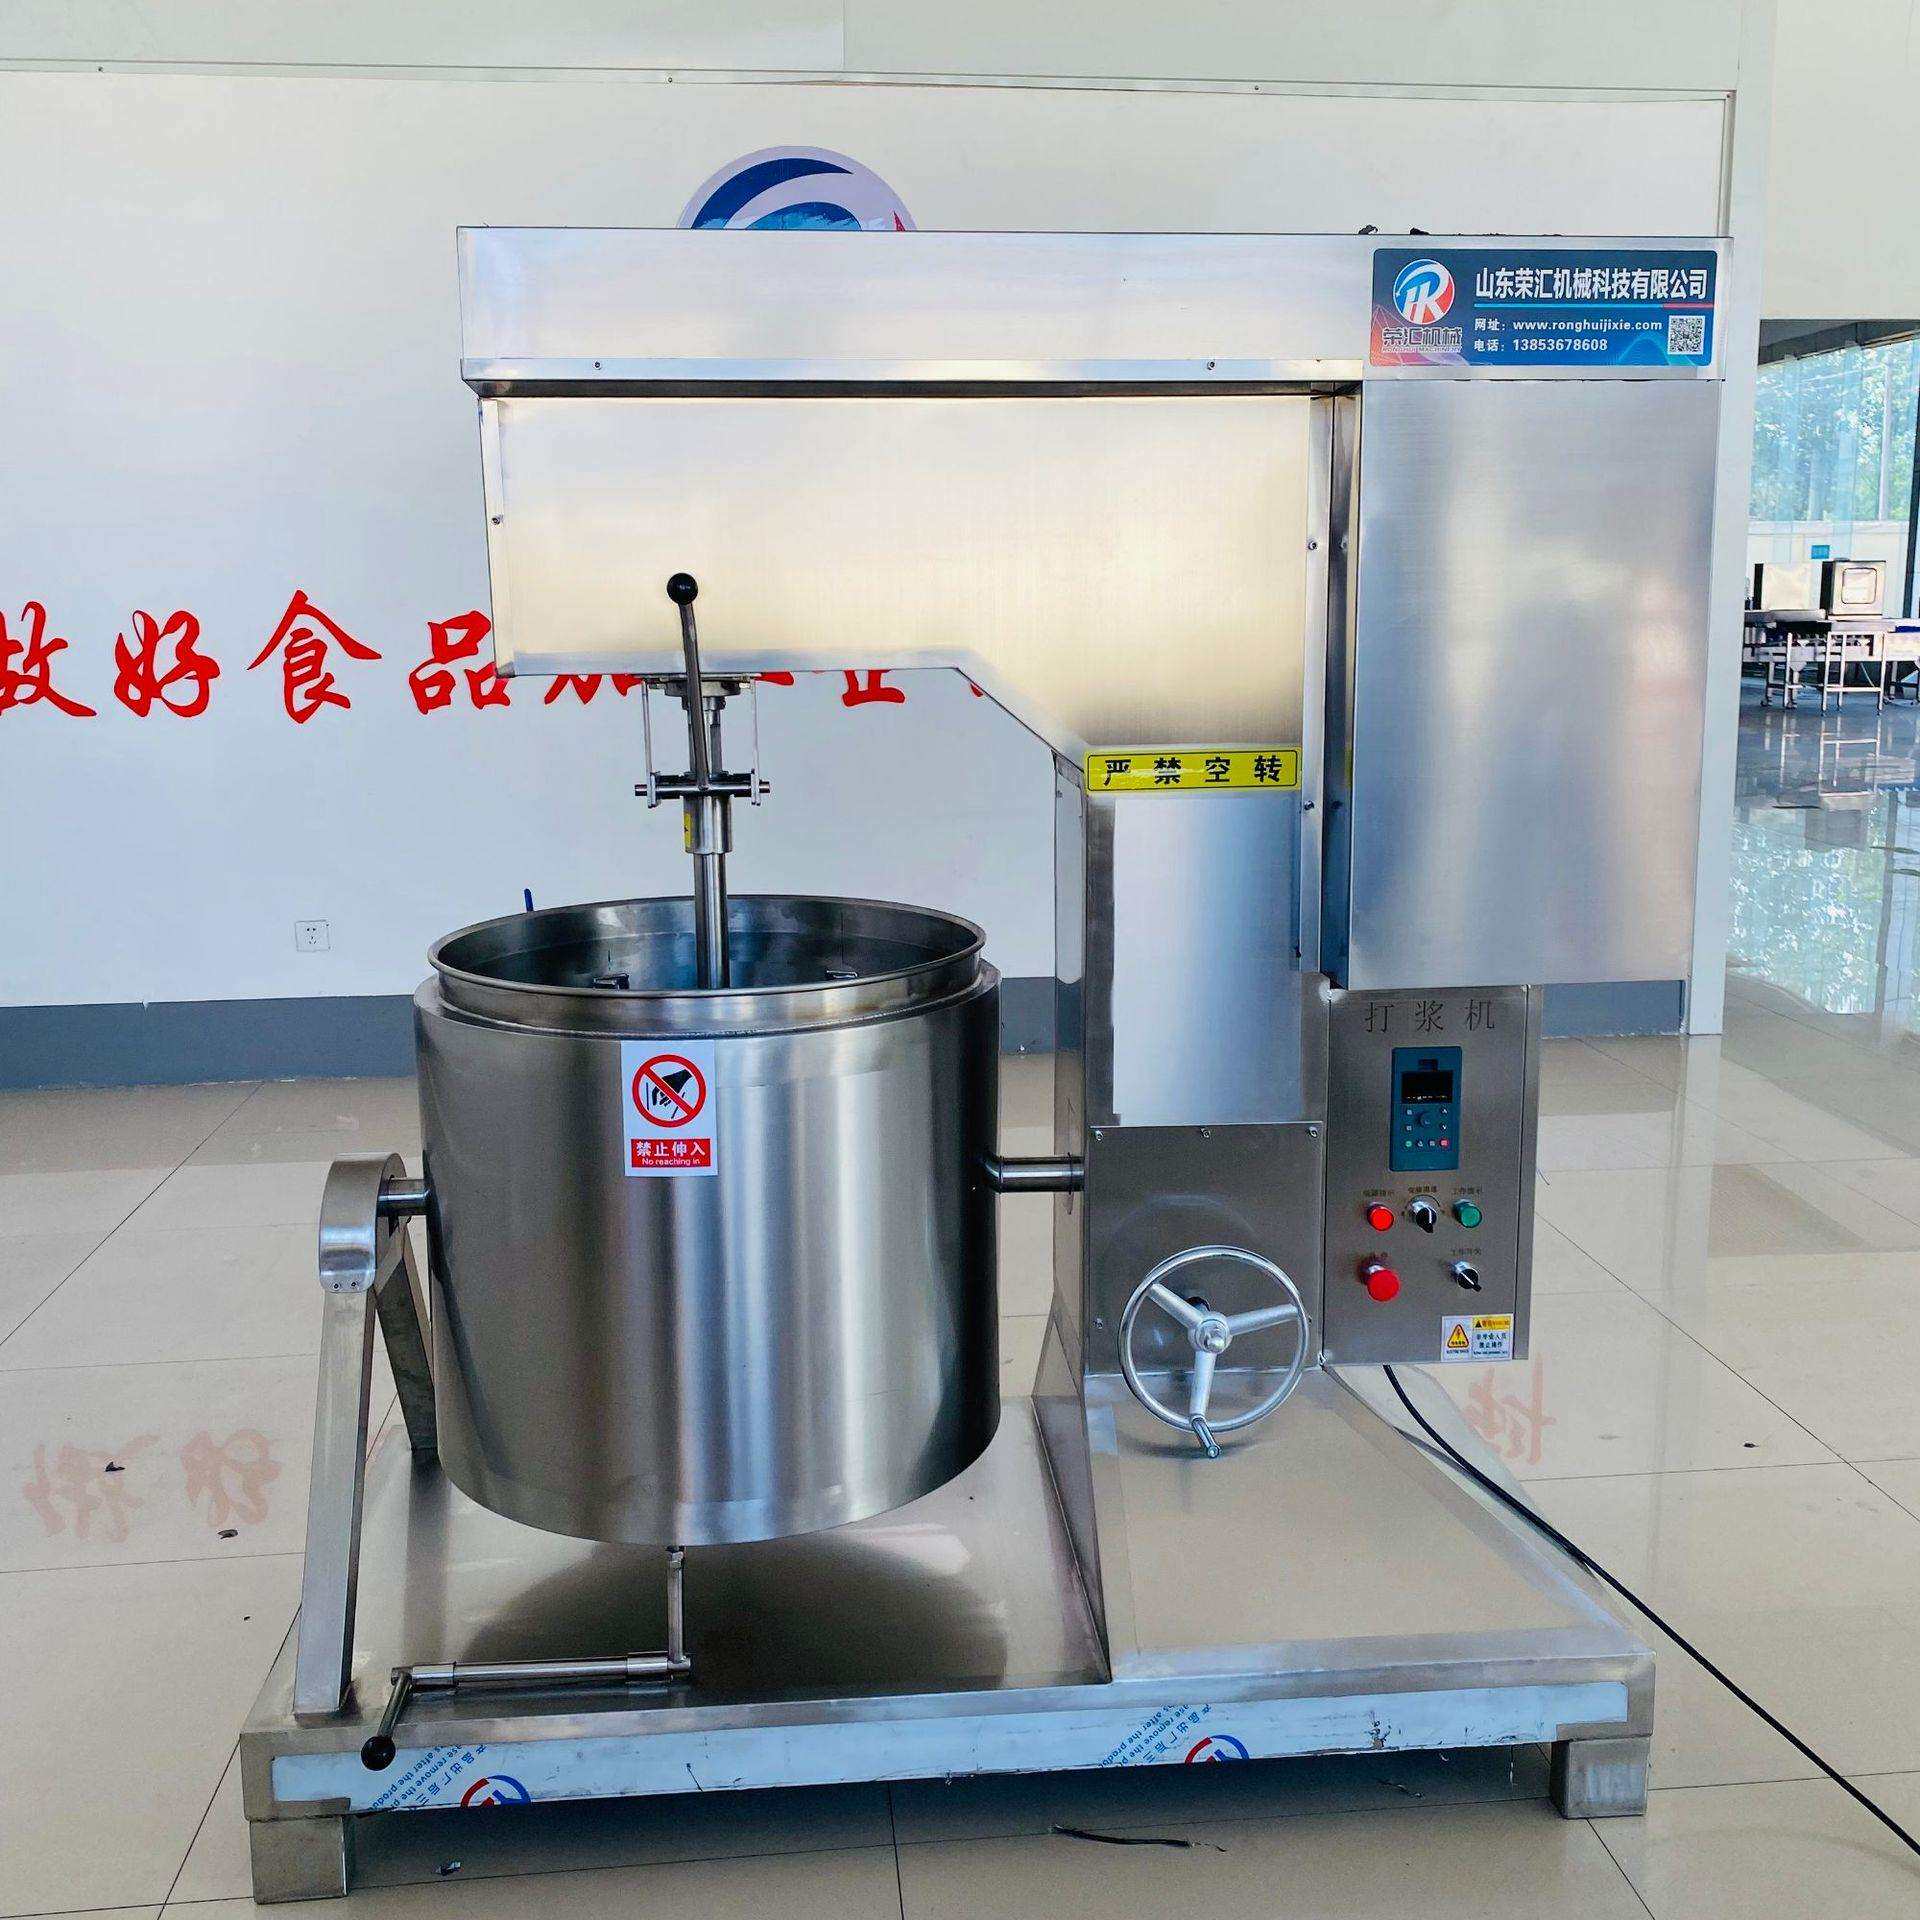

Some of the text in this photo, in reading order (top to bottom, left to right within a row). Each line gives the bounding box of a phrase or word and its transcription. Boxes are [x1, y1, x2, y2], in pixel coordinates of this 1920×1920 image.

[1475, 267, 1708, 300] 山东荣汇机械科技有限公司
[1512, 319, 1663, 333] www.ronghuijixie.com
[1382, 327, 1462, 347] 荣汇机械
[1513, 338, 1608, 351] 13853678608
[1103, 755, 1283, 787] 严禁空转
[1364, 999, 1495, 1033] 打浆机
[636, 1141, 706, 1157] 禁止伸入
[655, 1158, 691, 1166] reaching
[693, 1157, 701, 1165] in
[413, 1752, 434, 1773] after
[415, 1757, 447, 1787] remove
